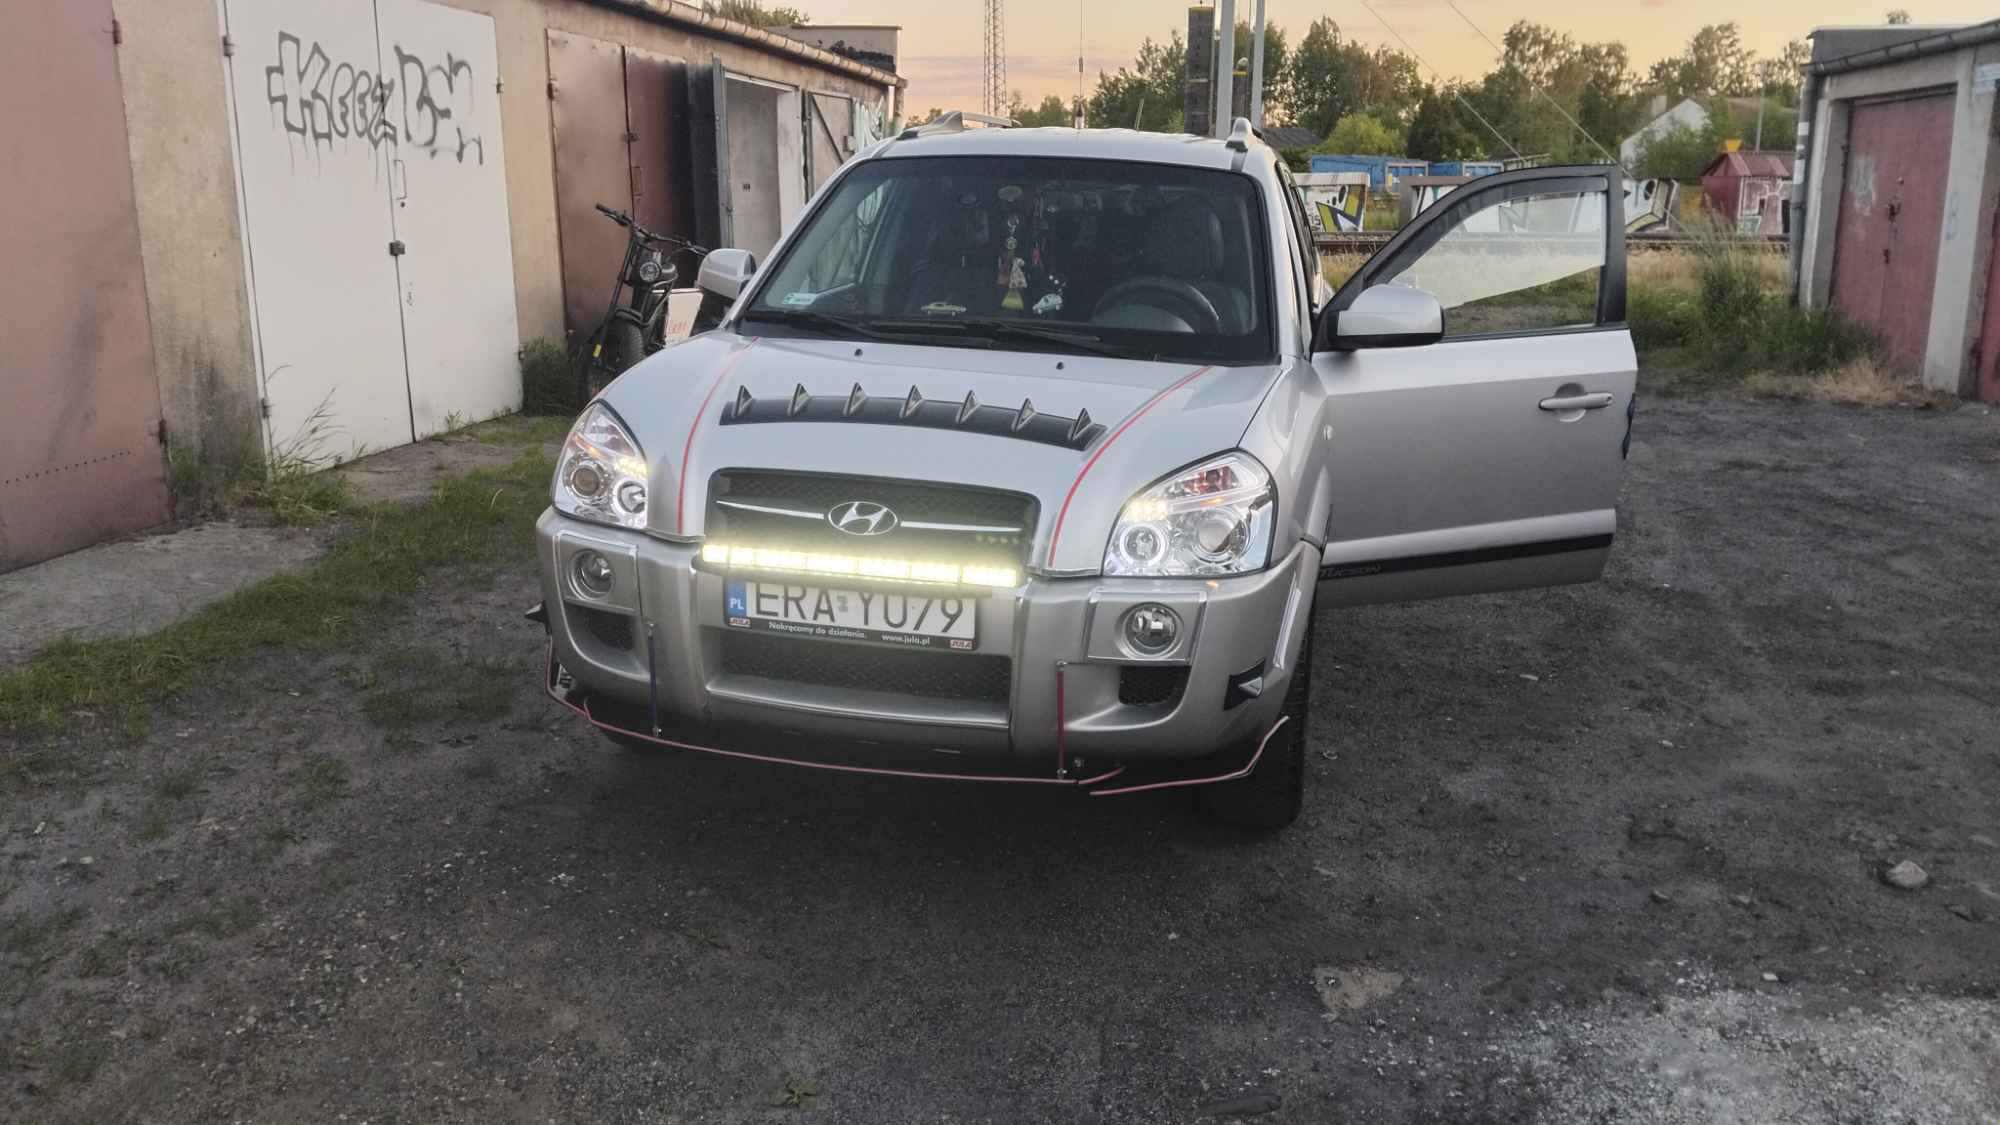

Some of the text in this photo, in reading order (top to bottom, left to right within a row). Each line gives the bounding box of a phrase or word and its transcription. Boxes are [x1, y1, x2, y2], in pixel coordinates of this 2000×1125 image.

[729, 597, 744, 610] PL
[755, 583, 835, 622] ERA
[815, 626, 826, 634] do
[881, 633, 930, 646] www.jula.pl
